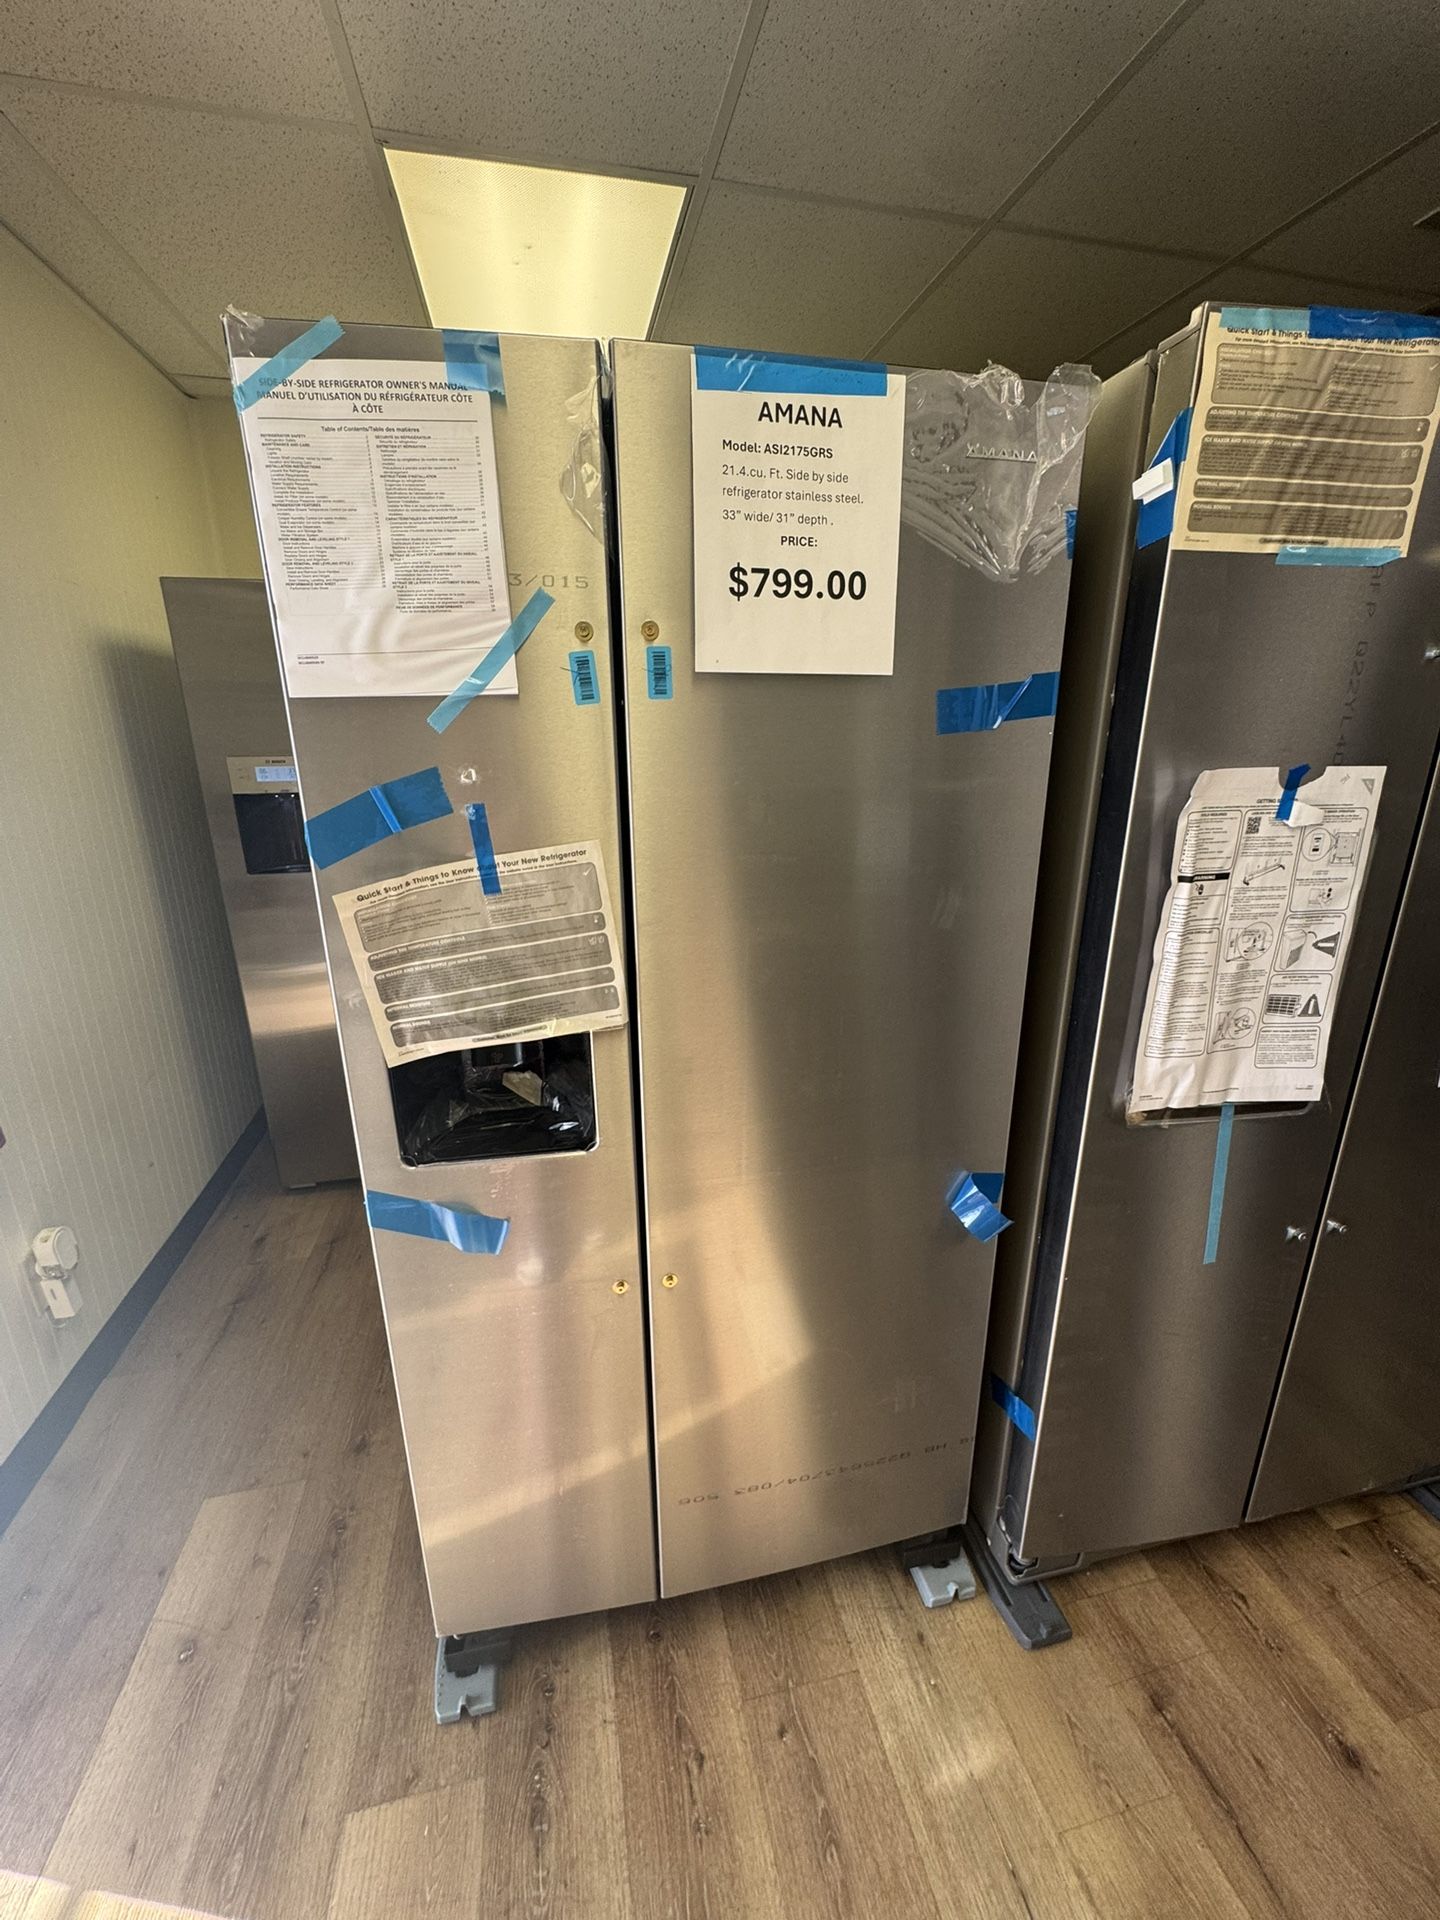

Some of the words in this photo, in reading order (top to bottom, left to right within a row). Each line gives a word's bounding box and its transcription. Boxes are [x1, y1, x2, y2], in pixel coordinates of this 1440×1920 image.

[1252, 328, 1269, 336] Start
[1278, 329, 1302, 339] Things
[318, 379, 384, 389] REFRIGERATOR
[386, 381, 427, 390] OWNER'S
[429, 382, 469, 391] MANUAL
[298, 392, 362, 401] D'UTILISATION
[364, 393, 377, 401] DU
[379, 392, 449, 403] RÉFRIGÉRATEUR
[451, 393, 473, 403] CÔTE
[352, 402, 359, 413] À
[361, 403, 384, 414] CÔTE
[758, 402, 843, 429] AMANA
[722, 439, 761, 453] Model:
[764, 443, 833, 459] ASI2175GRS
[966, 443, 1037, 461] AMANA
[722, 464, 766, 478] 21.4.cu.
[770, 468, 783, 479] Ft.
[786, 469, 810, 480] Side
[812, 471, 824, 484] by
[827, 472, 848, 483] side
[722, 486, 782, 500] refrigerator
[785, 491, 833, 503] stainless
[835, 493, 864, 504] steel.
[722, 509, 741, 520] 33"
[744, 511, 773, 522] wide/
[776, 513, 795, 523] 31"
[797, 514, 828, 526] depth
[780, 535, 818, 549] PRICE:
[727, 562, 867, 602] $799.00
[356, 888, 383, 903] Quick
[384, 883, 403, 895] Start
[412, 873, 440, 887] Things
[441, 871, 450, 879] to
[452, 866, 475, 876] Know
[502, 858, 519, 868] Your
[521, 856, 539, 866] New
[540, 849, 587, 864] Refrigerator
